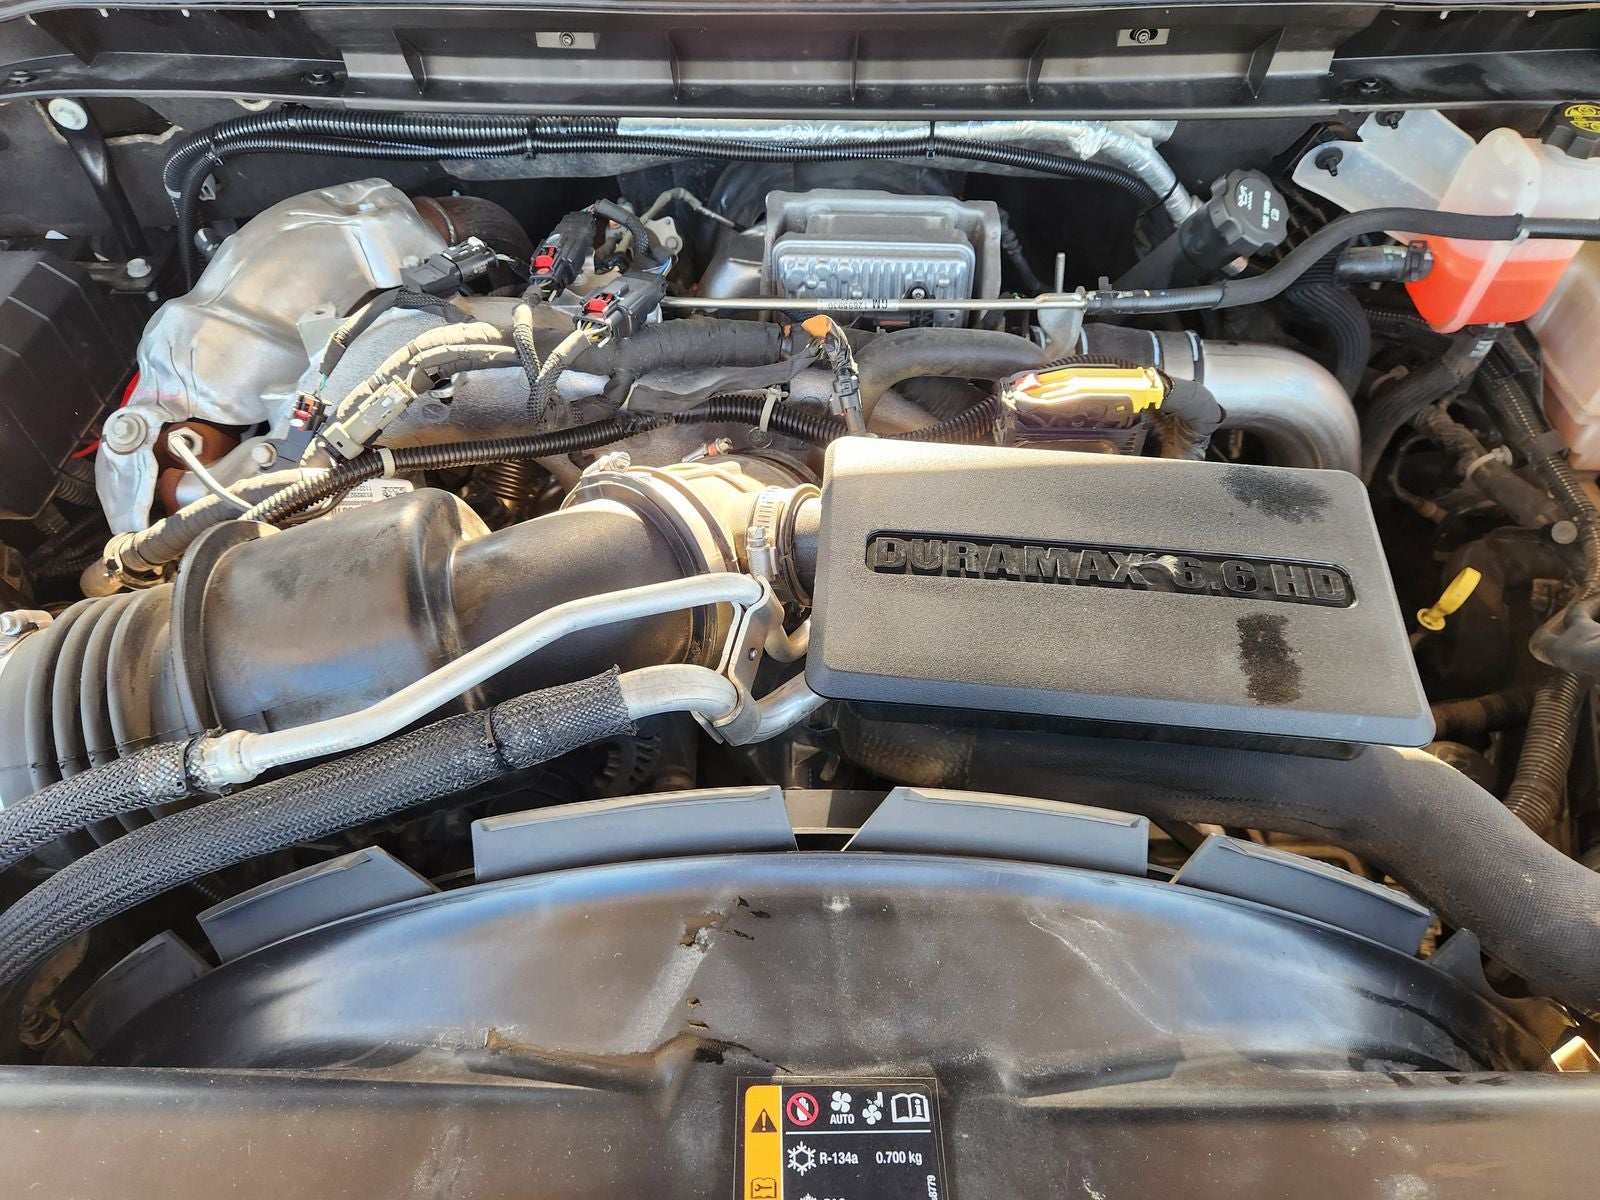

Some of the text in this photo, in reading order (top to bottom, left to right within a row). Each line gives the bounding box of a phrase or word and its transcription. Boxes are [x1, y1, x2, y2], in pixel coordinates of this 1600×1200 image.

[873, 299, 888, 309] GM
[874, 536, 1347, 600] DURAMAX 6.6 HD
[829, 1113, 855, 1125] AUTO
[819, 1150, 923, 1166] R-134a 0.700 kg
